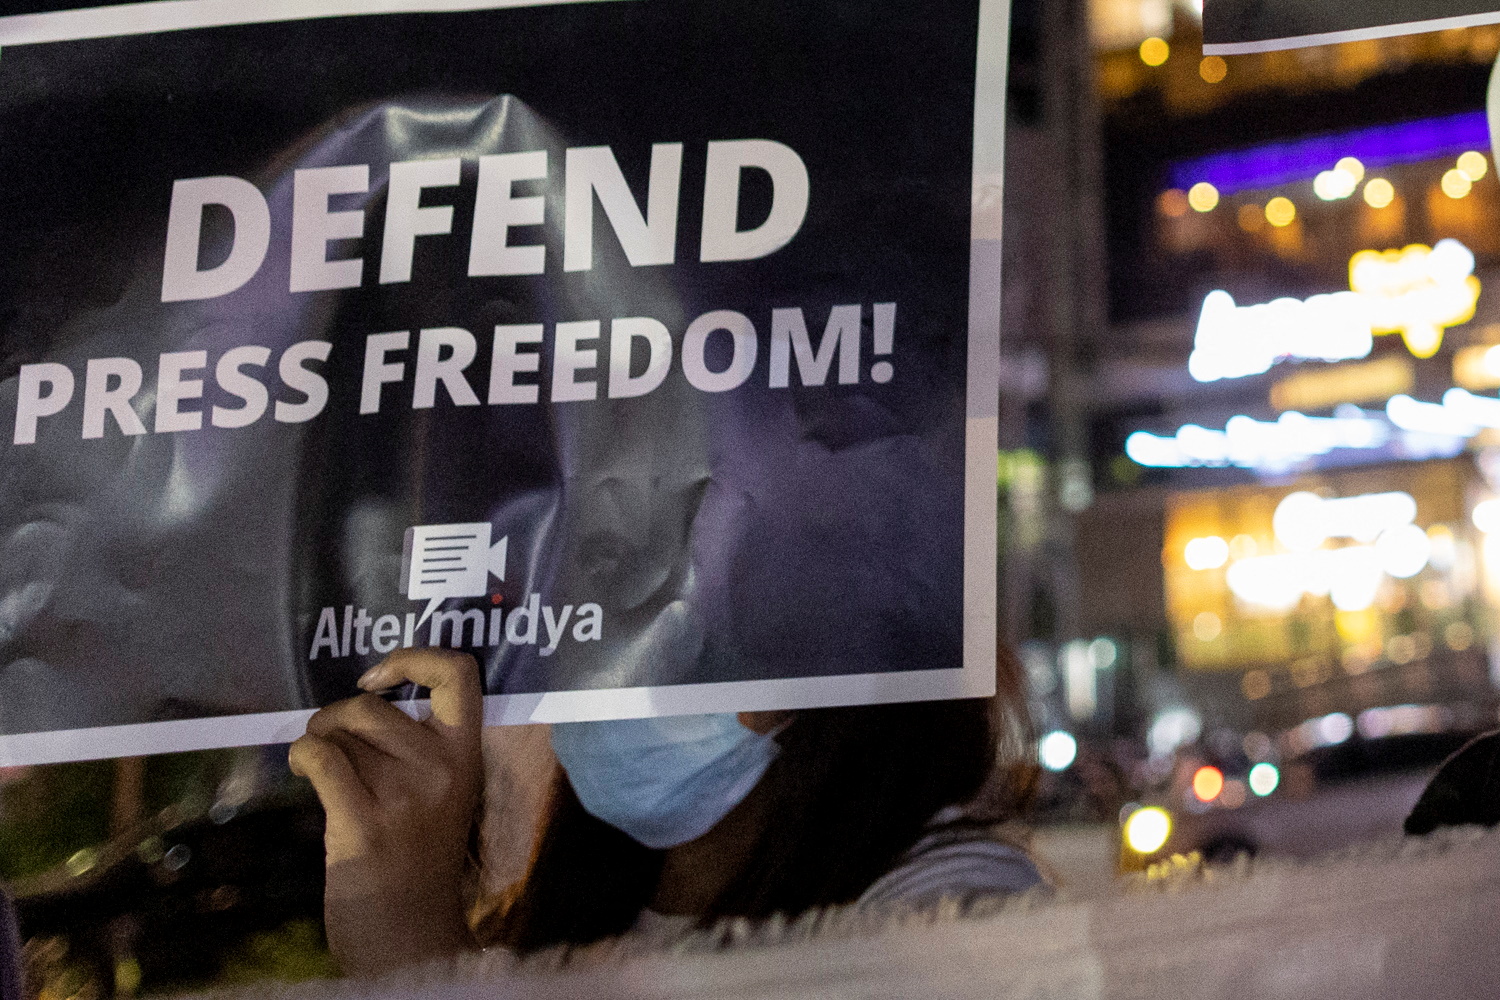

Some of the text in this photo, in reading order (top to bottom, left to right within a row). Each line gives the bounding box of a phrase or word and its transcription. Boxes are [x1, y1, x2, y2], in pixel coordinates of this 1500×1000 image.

[161, 137, 811, 303] DEFEND
[13, 302, 898, 446] PRESS FREEDOM!
[308, 592, 604, 661] Altermidya
